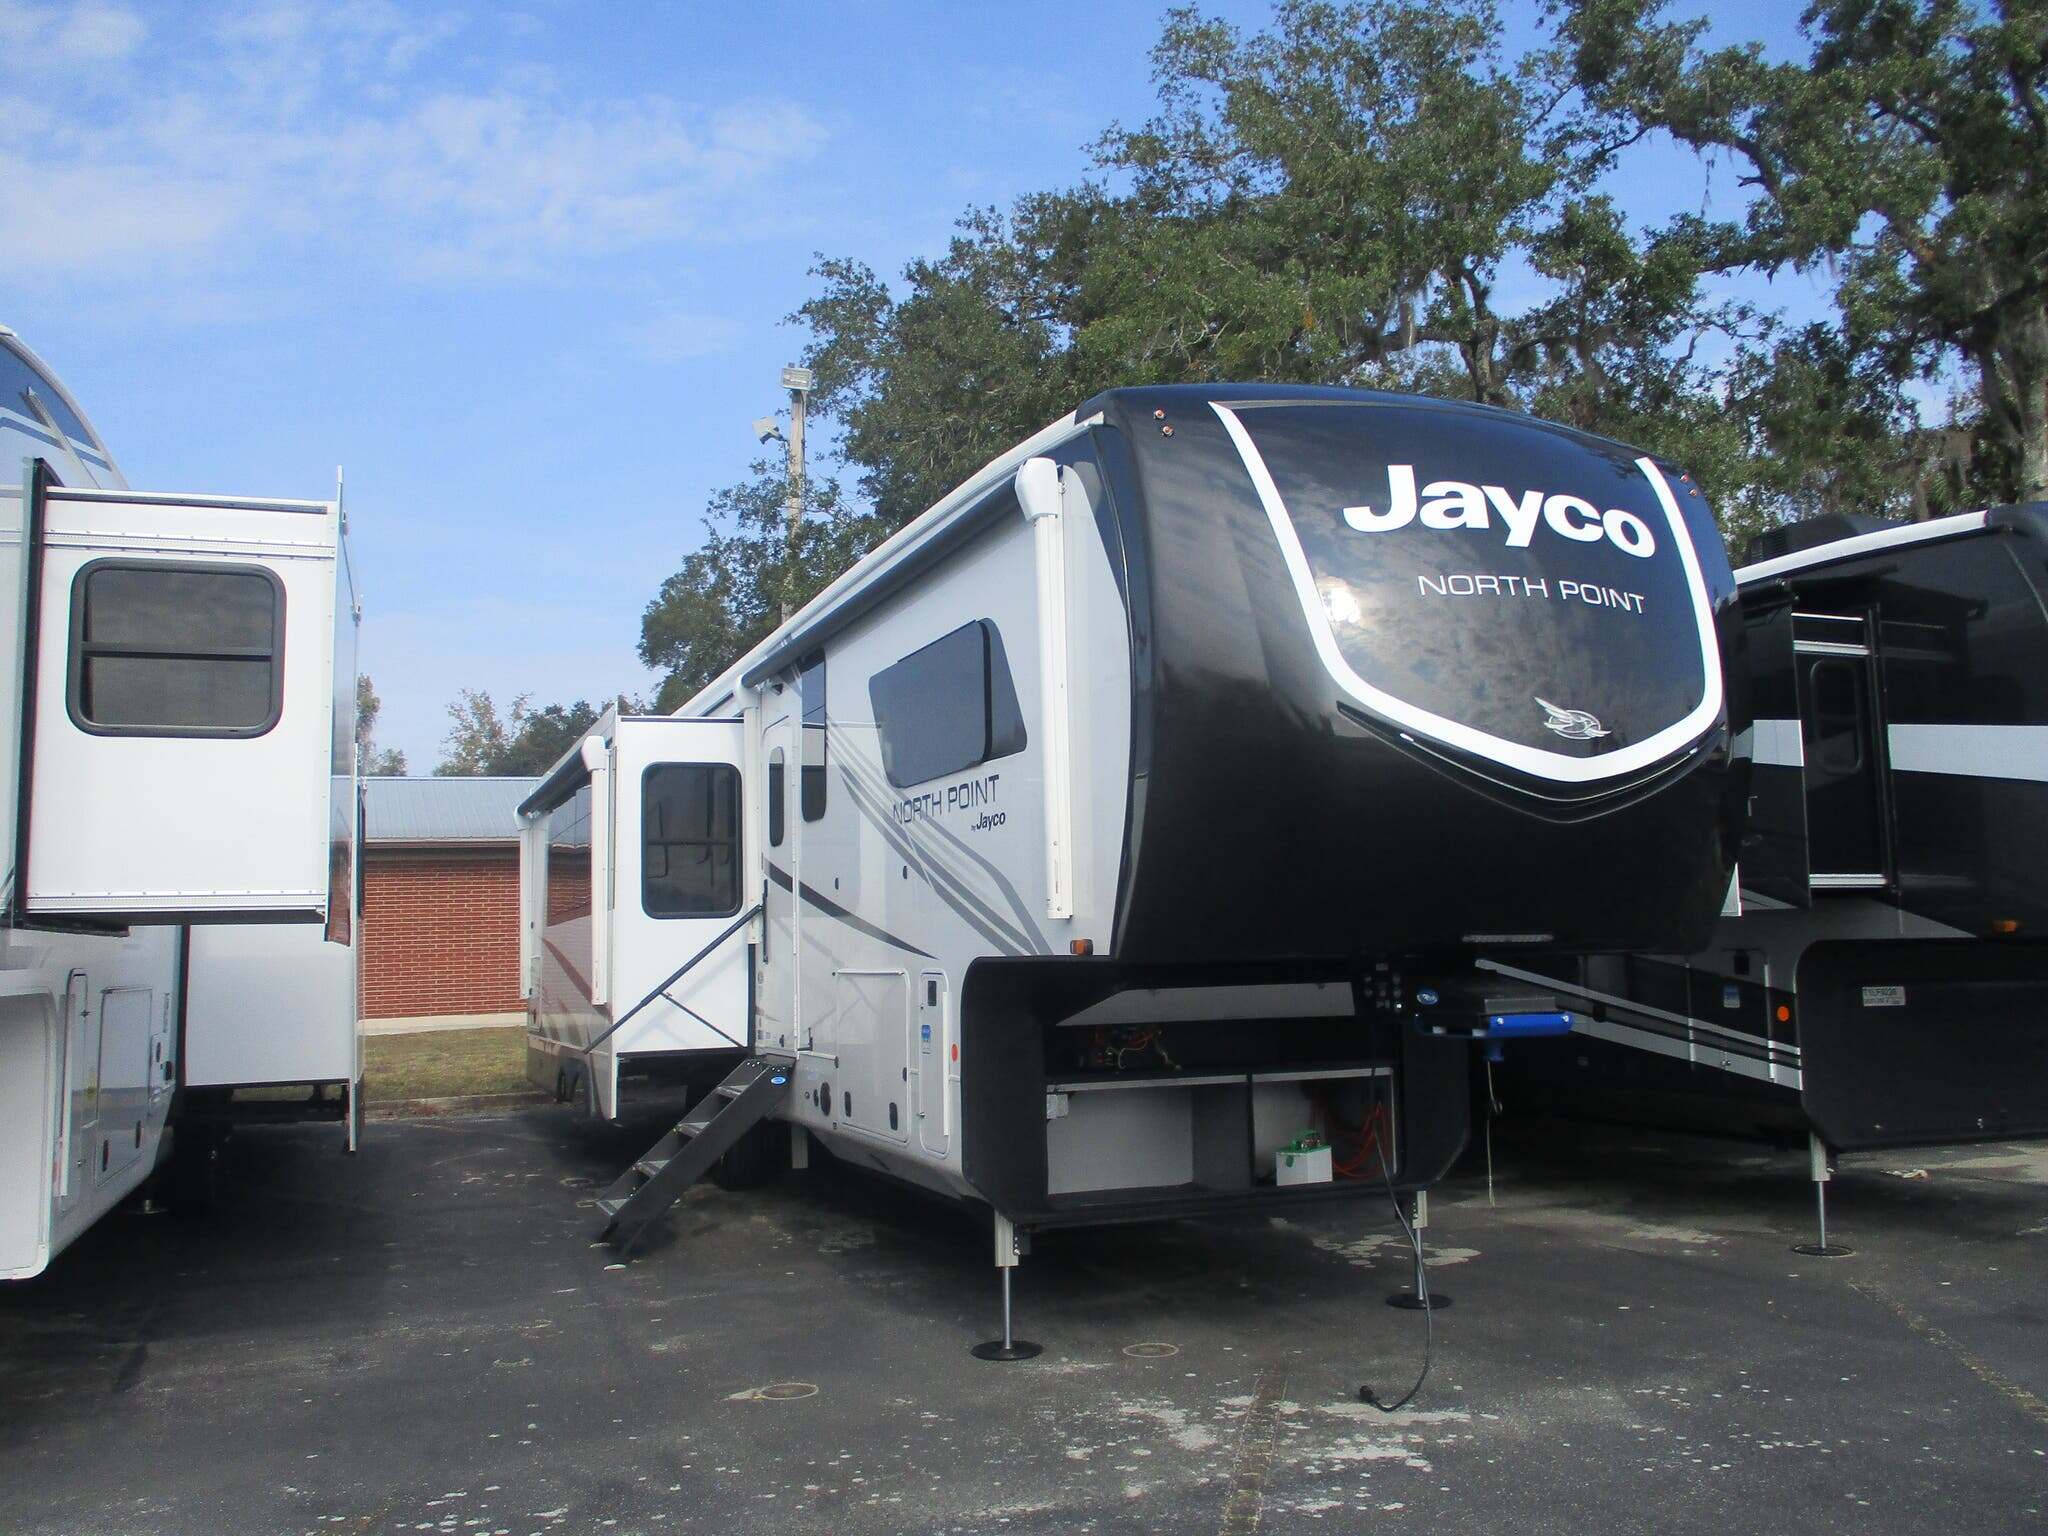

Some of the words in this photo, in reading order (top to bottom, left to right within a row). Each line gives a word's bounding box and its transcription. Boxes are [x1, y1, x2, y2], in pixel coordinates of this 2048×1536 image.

[1343, 464, 1656, 558] Jayco
[1417, 574, 1549, 600] NORTH
[1558, 579, 1646, 615] POINT
[893, 790, 943, 825] NORTH
[948, 774, 999, 812] POINT
[976, 812, 1006, 831] Jayco
